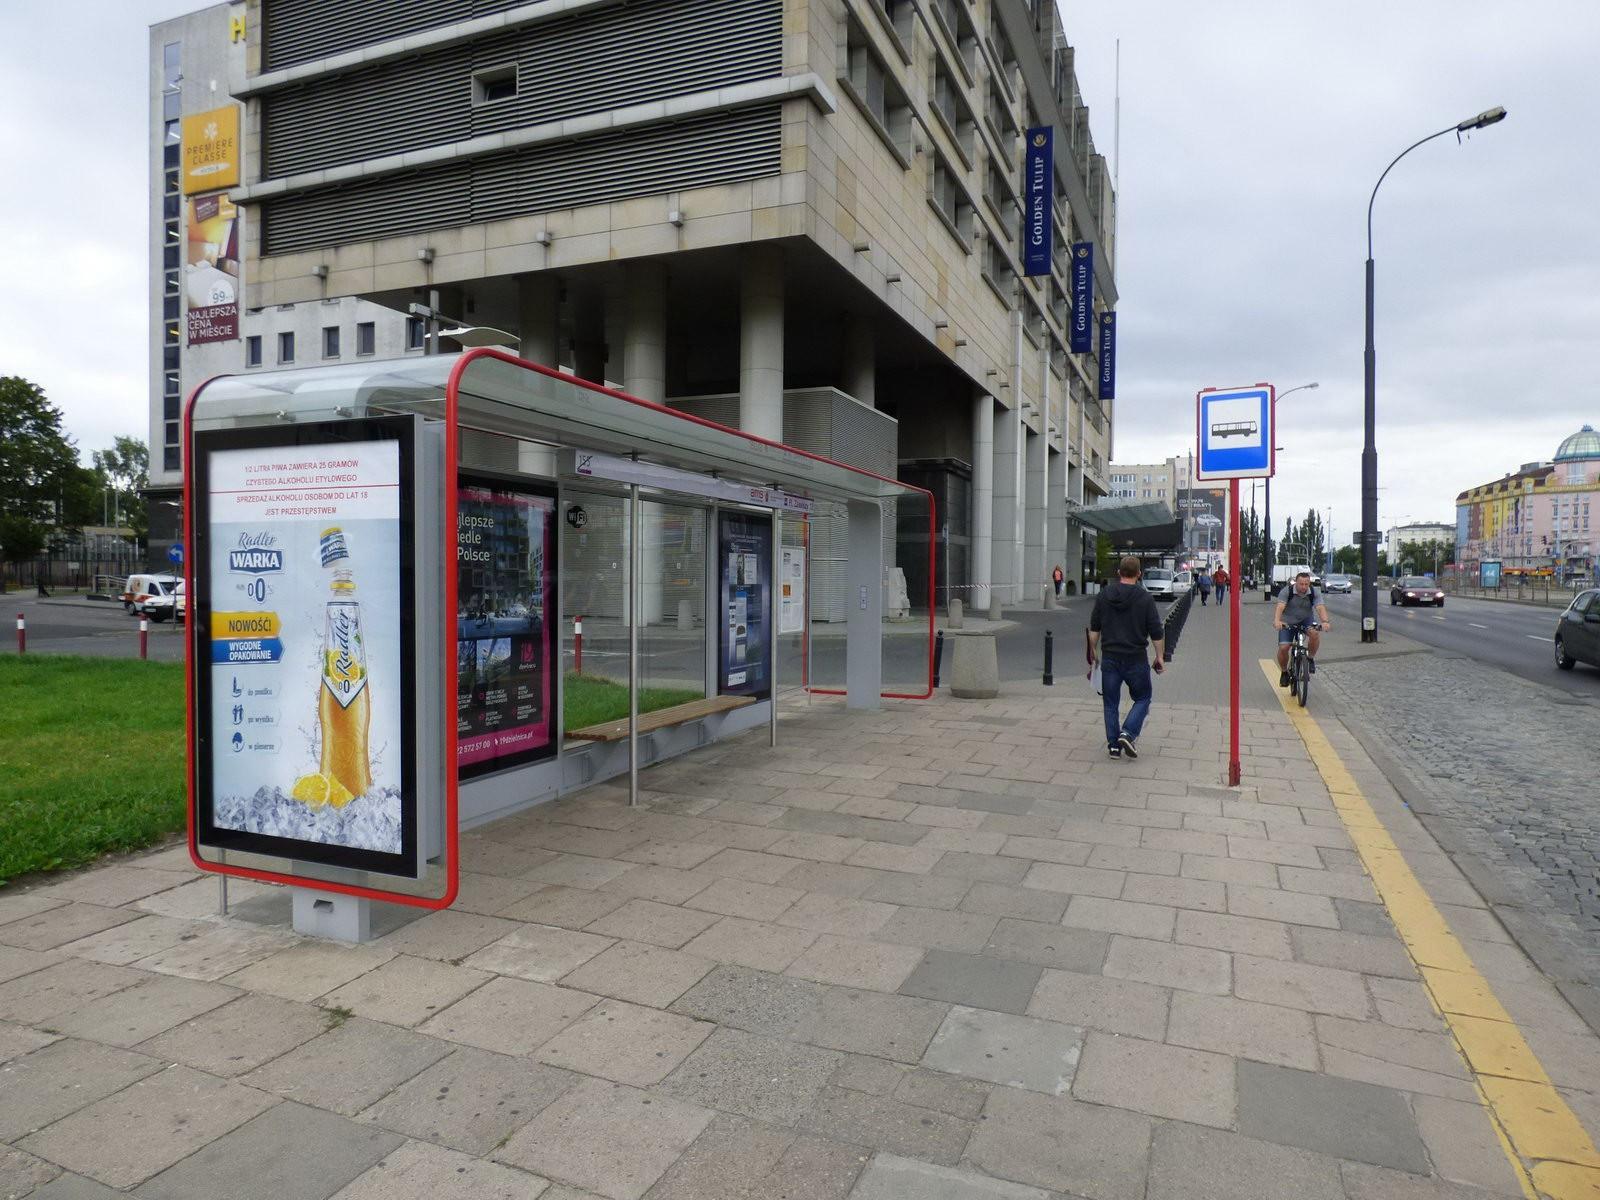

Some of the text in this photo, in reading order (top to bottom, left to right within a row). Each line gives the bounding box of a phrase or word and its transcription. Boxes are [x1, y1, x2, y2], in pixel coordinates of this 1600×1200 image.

[192, 149, 227, 165] CLASSE
[1033, 156, 1044, 192] TULIP
[1032, 196, 1044, 245] GOLDEN
[1078, 264, 1087, 291] TULIP
[212, 291, 225, 304] 99
[188, 306, 237, 320] NAJLEPSZA
[1077, 295, 1087, 331] GOLDEN
[188, 319, 212, 330] CENA
[189, 325, 233, 339] W MIEŚCIE
[1103, 329, 1112, 383] GOLDEN TULIP
[271, 463, 288, 472] PIWA
[288, 462, 318, 471] ZAWIERA
[245, 474, 358, 486] CZYSTEGO ALKOHOLU ETYLOWEGO
[268, 493, 303, 502] ALKOHOLU
[304, 492, 334, 501] OSOBOM
[334, 492, 345, 500] DO
[346, 491, 359, 500] LAT
[750, 488, 764, 499] ams
[265, 508, 279, 516] JEST
[457, 512, 494, 530] jlepsze
[238, 531, 277, 549] Radler
[457, 530, 482, 544] iedle
[231, 552, 280, 568] WARKA
[457, 546, 491, 561] Polsce
[228, 616, 272, 632] NOWOŚĆ!
[229, 641, 262, 651] WYGODNE
[229, 650, 272, 661] OPAKOWANIE
[463, 744, 474, 753] 572
